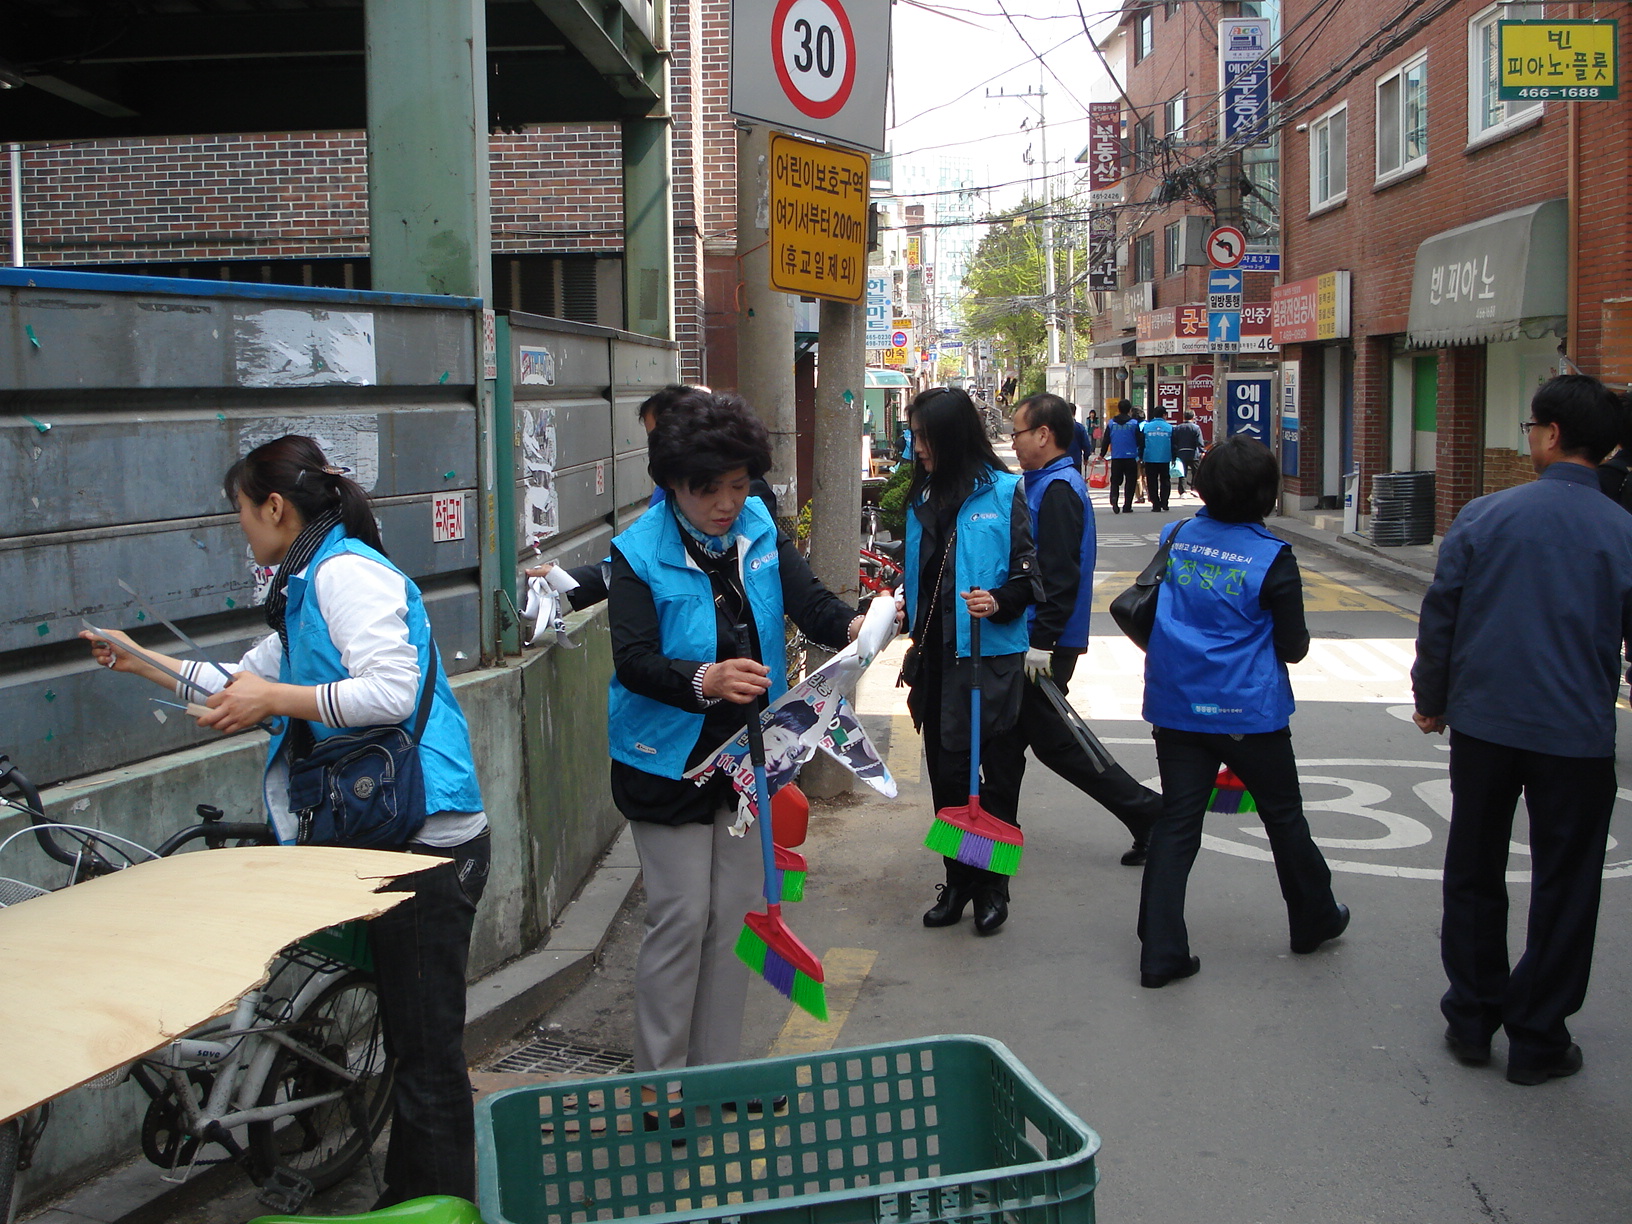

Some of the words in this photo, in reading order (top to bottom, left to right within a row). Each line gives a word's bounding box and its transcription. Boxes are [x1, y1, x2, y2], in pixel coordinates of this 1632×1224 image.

[1232, 26, 1259, 35] ace
[794, 19, 836, 78] 30
[1547, 31, 1572, 50] 빈
[1228, 63, 1265, 74] 에이스
[1518, 87, 1599, 98] 466-1688
[1232, 74, 1259, 135] 부동산
[1092, 124, 1118, 182] 부동산
[776, 154, 864, 202] 어린이보호구역
[776, 197, 830, 238] 여기서부터
[832, 211, 862, 244] 200m
[1243, 255, 1270, 264] 자로3길
[1430, 254, 1495, 306] 빈피아노
[1210, 295, 1240, 308] 일방통행
[1210, 343, 1237, 351] 일방통행
[1159, 384, 1181, 396] 굿모닝
[1236, 384, 1262, 440] 에이스
[1191, 544, 1219, 558] 살기좋은
[1220, 551, 1253, 564] 맑은도시
[196, 1049, 221, 1059] save
